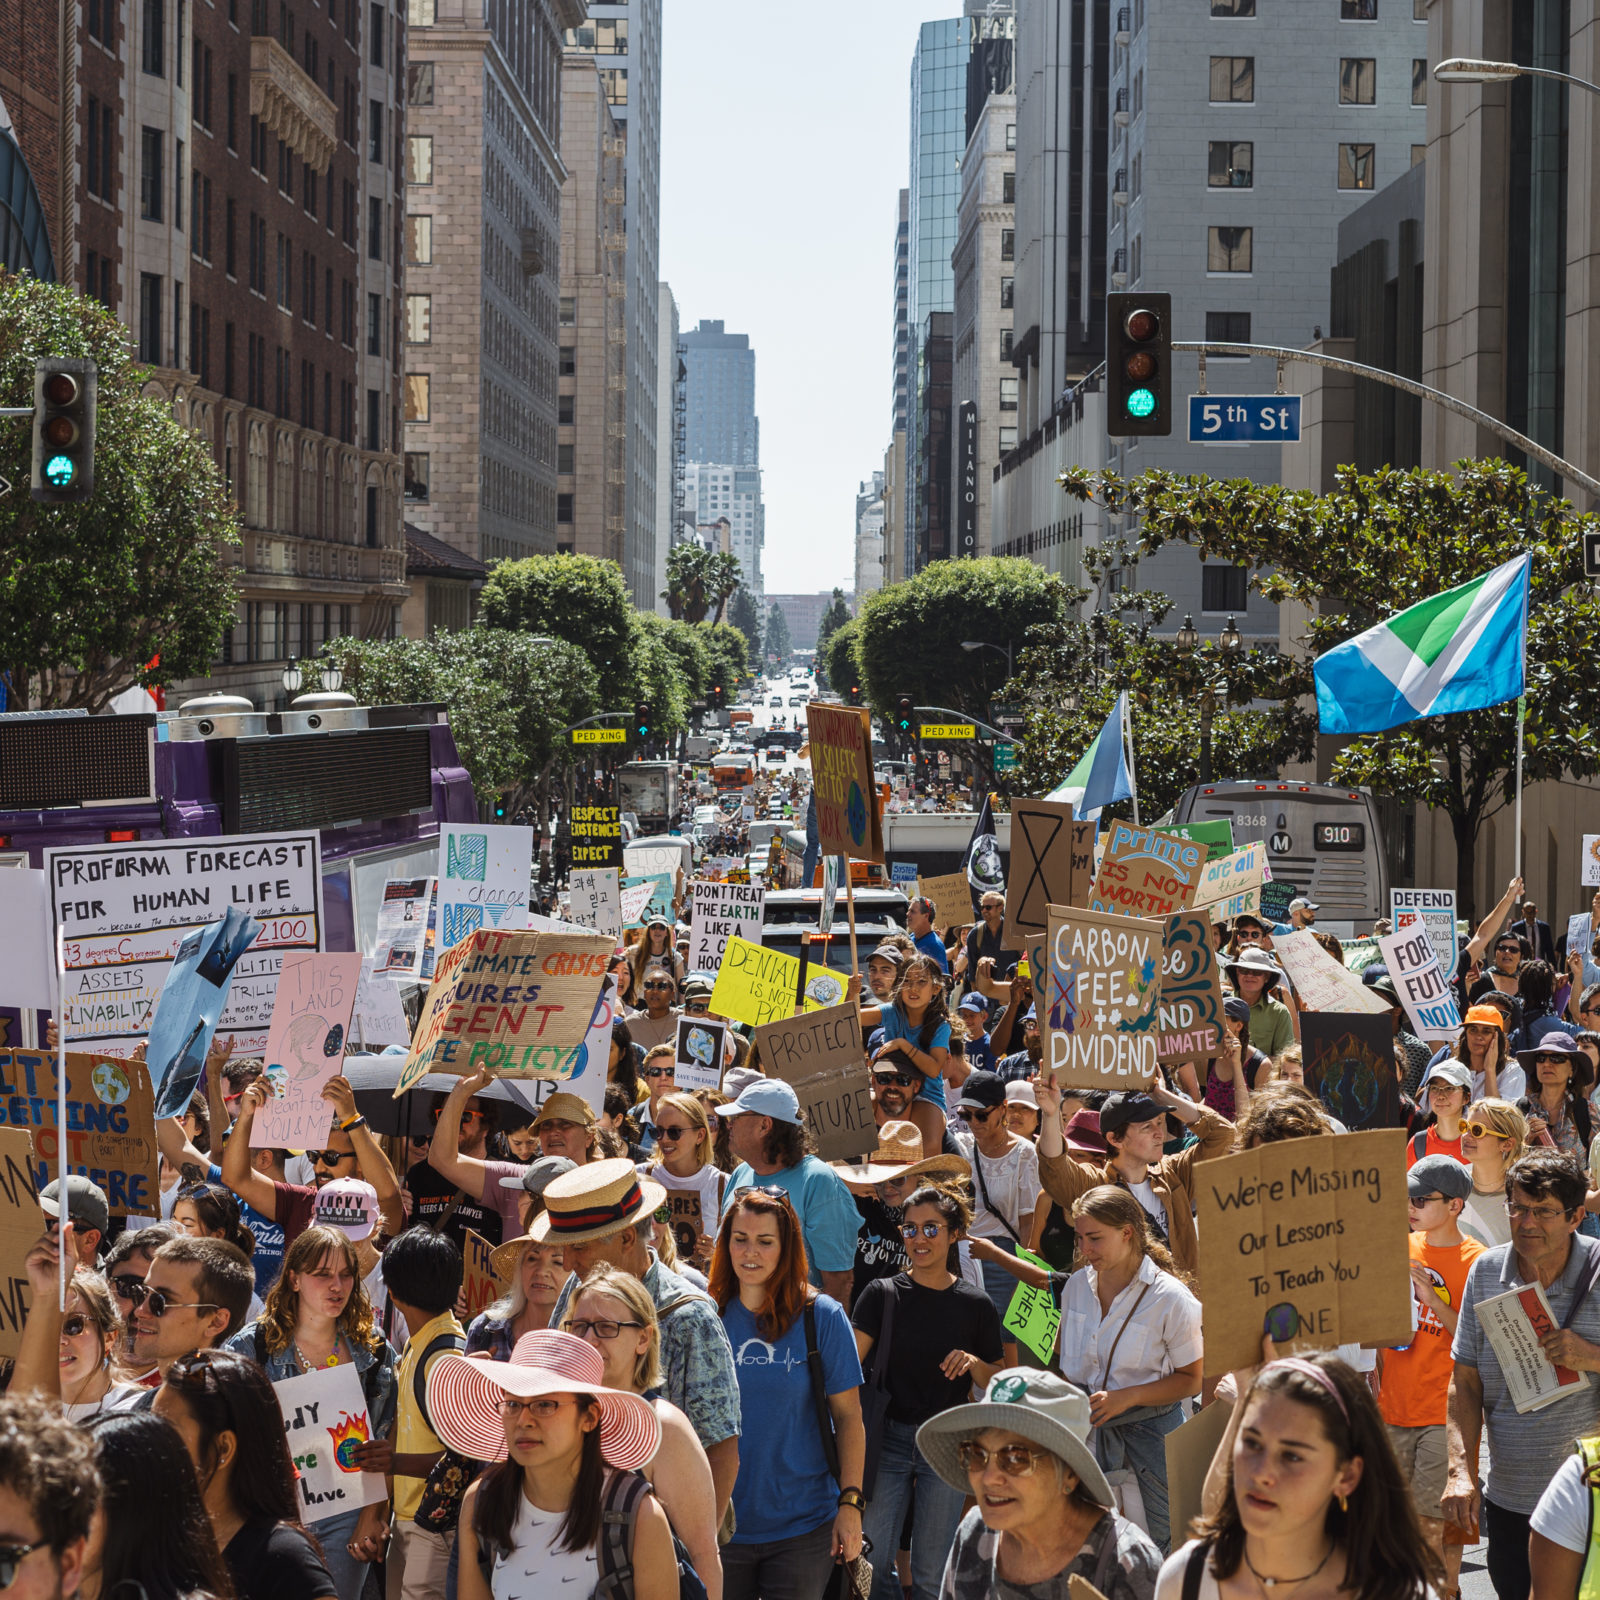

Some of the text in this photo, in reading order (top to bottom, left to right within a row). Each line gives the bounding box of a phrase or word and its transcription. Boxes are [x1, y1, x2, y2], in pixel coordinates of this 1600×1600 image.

[1202, 405, 1289, 433] 5th St
[965, 413, 975, 502] MILANO
[577, 731, 621, 741] PED XING
[925, 727, 970, 736] PED XING
[815, 772, 843, 804] GET TO
[571, 806, 619, 821] RESPECT
[1237, 815, 1266, 826] 8368
[571, 822, 621, 837] EXISTENCE
[1324, 827, 1350, 843] 910
[186, 845, 306, 874] FORECAST
[446, 833, 487, 881] NO
[572, 845, 613, 860] EXPECT
[1110, 825, 1199, 867] prime
[894, 866, 917, 874] SYSTEM
[1102, 861, 1129, 882] IS
[1143, 871, 1195, 900] NOT
[1207, 851, 1254, 882] are all
[61, 900, 107, 921] FOR
[133, 887, 210, 914] HUMAN
[231, 879, 291, 903] LIFE
[468, 882, 525, 920] change
[696, 884, 765, 903] DON'T TREAT
[1100, 879, 1173, 915] WORTH
[1393, 892, 1453, 907] DEFEND
[696, 902, 759, 920] THE EARTH
[1397, 913, 1426, 927] ZE
[85, 947, 117, 961] degrees
[117, 938, 132, 957] C
[256, 919, 307, 943] 2100
[705, 921, 742, 938] LIKE A
[434, 931, 515, 984] URGENT
[700, 938, 709, 952] 2
[1055, 924, 1149, 971] CARBON
[1393, 934, 1432, 971] FOR
[80, 968, 144, 992] ASSETS
[235, 958, 283, 975] ILITIE
[286, 958, 342, 995] This
[452, 951, 610, 983] CLIMATE CRISIS
[729, 942, 800, 991] DENIAL
[231, 984, 277, 1001] TRILLI
[290, 988, 344, 1016] LAND
[430, 981, 542, 1020] REQUIRES
[750, 981, 796, 1008] IS NOT
[1077, 970, 1124, 1006] FEE
[69, 998, 154, 1025] LIVABILITY
[235, 1003, 259, 1016] money
[1159, 1003, 1193, 1032] ND
[1416, 998, 1462, 1028] NOW
[415, 1004, 565, 1056] URGENT
[768, 1015, 856, 1069] PROTECT
[1157, 1028, 1216, 1057] LIMATE
[400, 1039, 582, 1089] CLIMATE POLICY!
[1051, 1031, 1157, 1078] DIVIDEND
[288, 1081, 302, 1097] is
[676, 1073, 718, 1086] SAVE THE EARTH
[807, 1088, 871, 1136] ATURE
[262, 1117, 292, 1142] YOU
[304, 1114, 333, 1142] ME
[35, 1127, 89, 1162] OT
[1212, 1166, 1381, 1212] We're Missing
[319, 1195, 363, 1217] LUCKY
[419, 1204, 438, 1214] NEEDS
[458, 1205, 483, 1219] LAWYER
[1239, 1219, 1345, 1256] Our Lessons
[1249, 1259, 1360, 1297] To Teach You
[1497, 1301, 1541, 1395] Trump Continues the Bloody
[1513, 1319, 1524, 1334] Deal
[1521, 1334, 1528, 1342] or
[1527, 1342, 1534, 1352] No
[1502, 1326, 1511, 1340] War
[1510, 1340, 1515, 1348] in
[1513, 1348, 1532, 1390] Afghanistan
[301, 1477, 346, 1506] have
